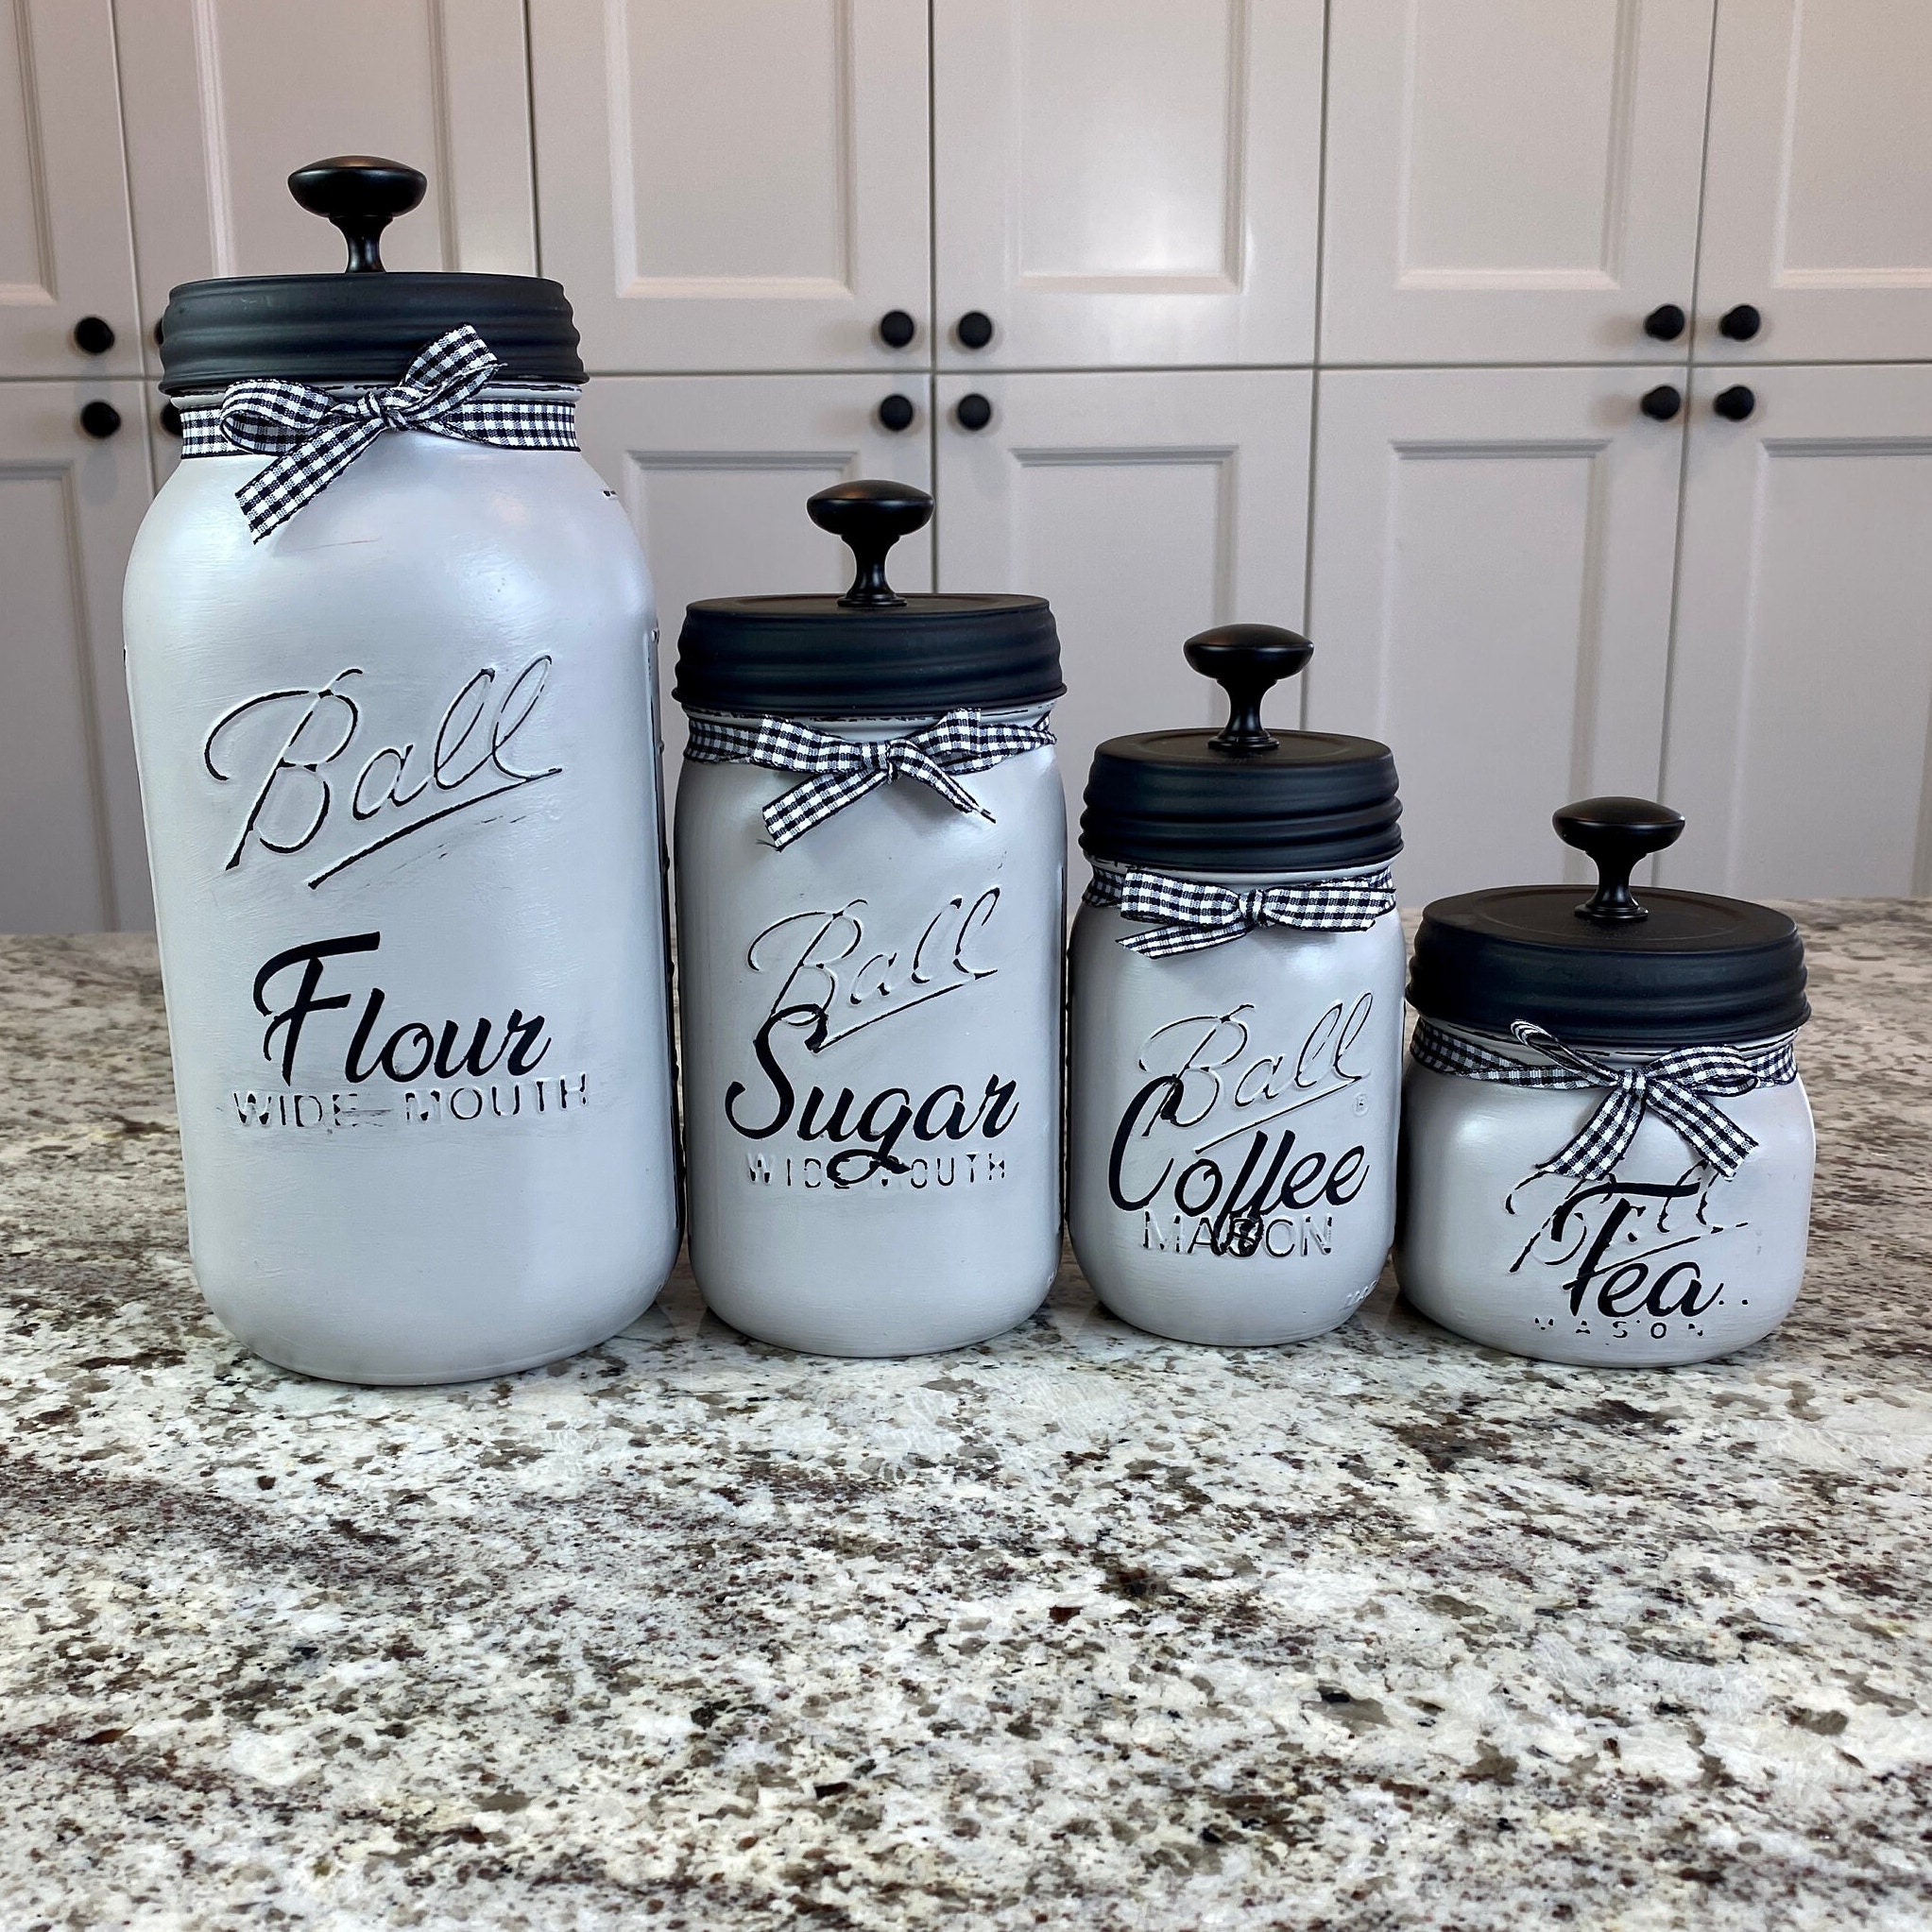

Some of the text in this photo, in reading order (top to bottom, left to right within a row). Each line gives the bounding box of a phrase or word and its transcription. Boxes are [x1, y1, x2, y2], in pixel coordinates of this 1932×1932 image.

[203, 653, 563, 874] Ball
[251, 931, 553, 1086] Flour
[746, 886, 1000, 1048] Ball
[231, 1071, 590, 1128] WIDE MOUTH
[724, 1003, 1020, 1187] Sugar
[1137, 991, 1374, 1137] Ball
[864, 1152, 1006, 1189] OUTH
[1107, 1074, 1371, 1257] Coffee
[1549, 1181, 1725, 1318] Tea
